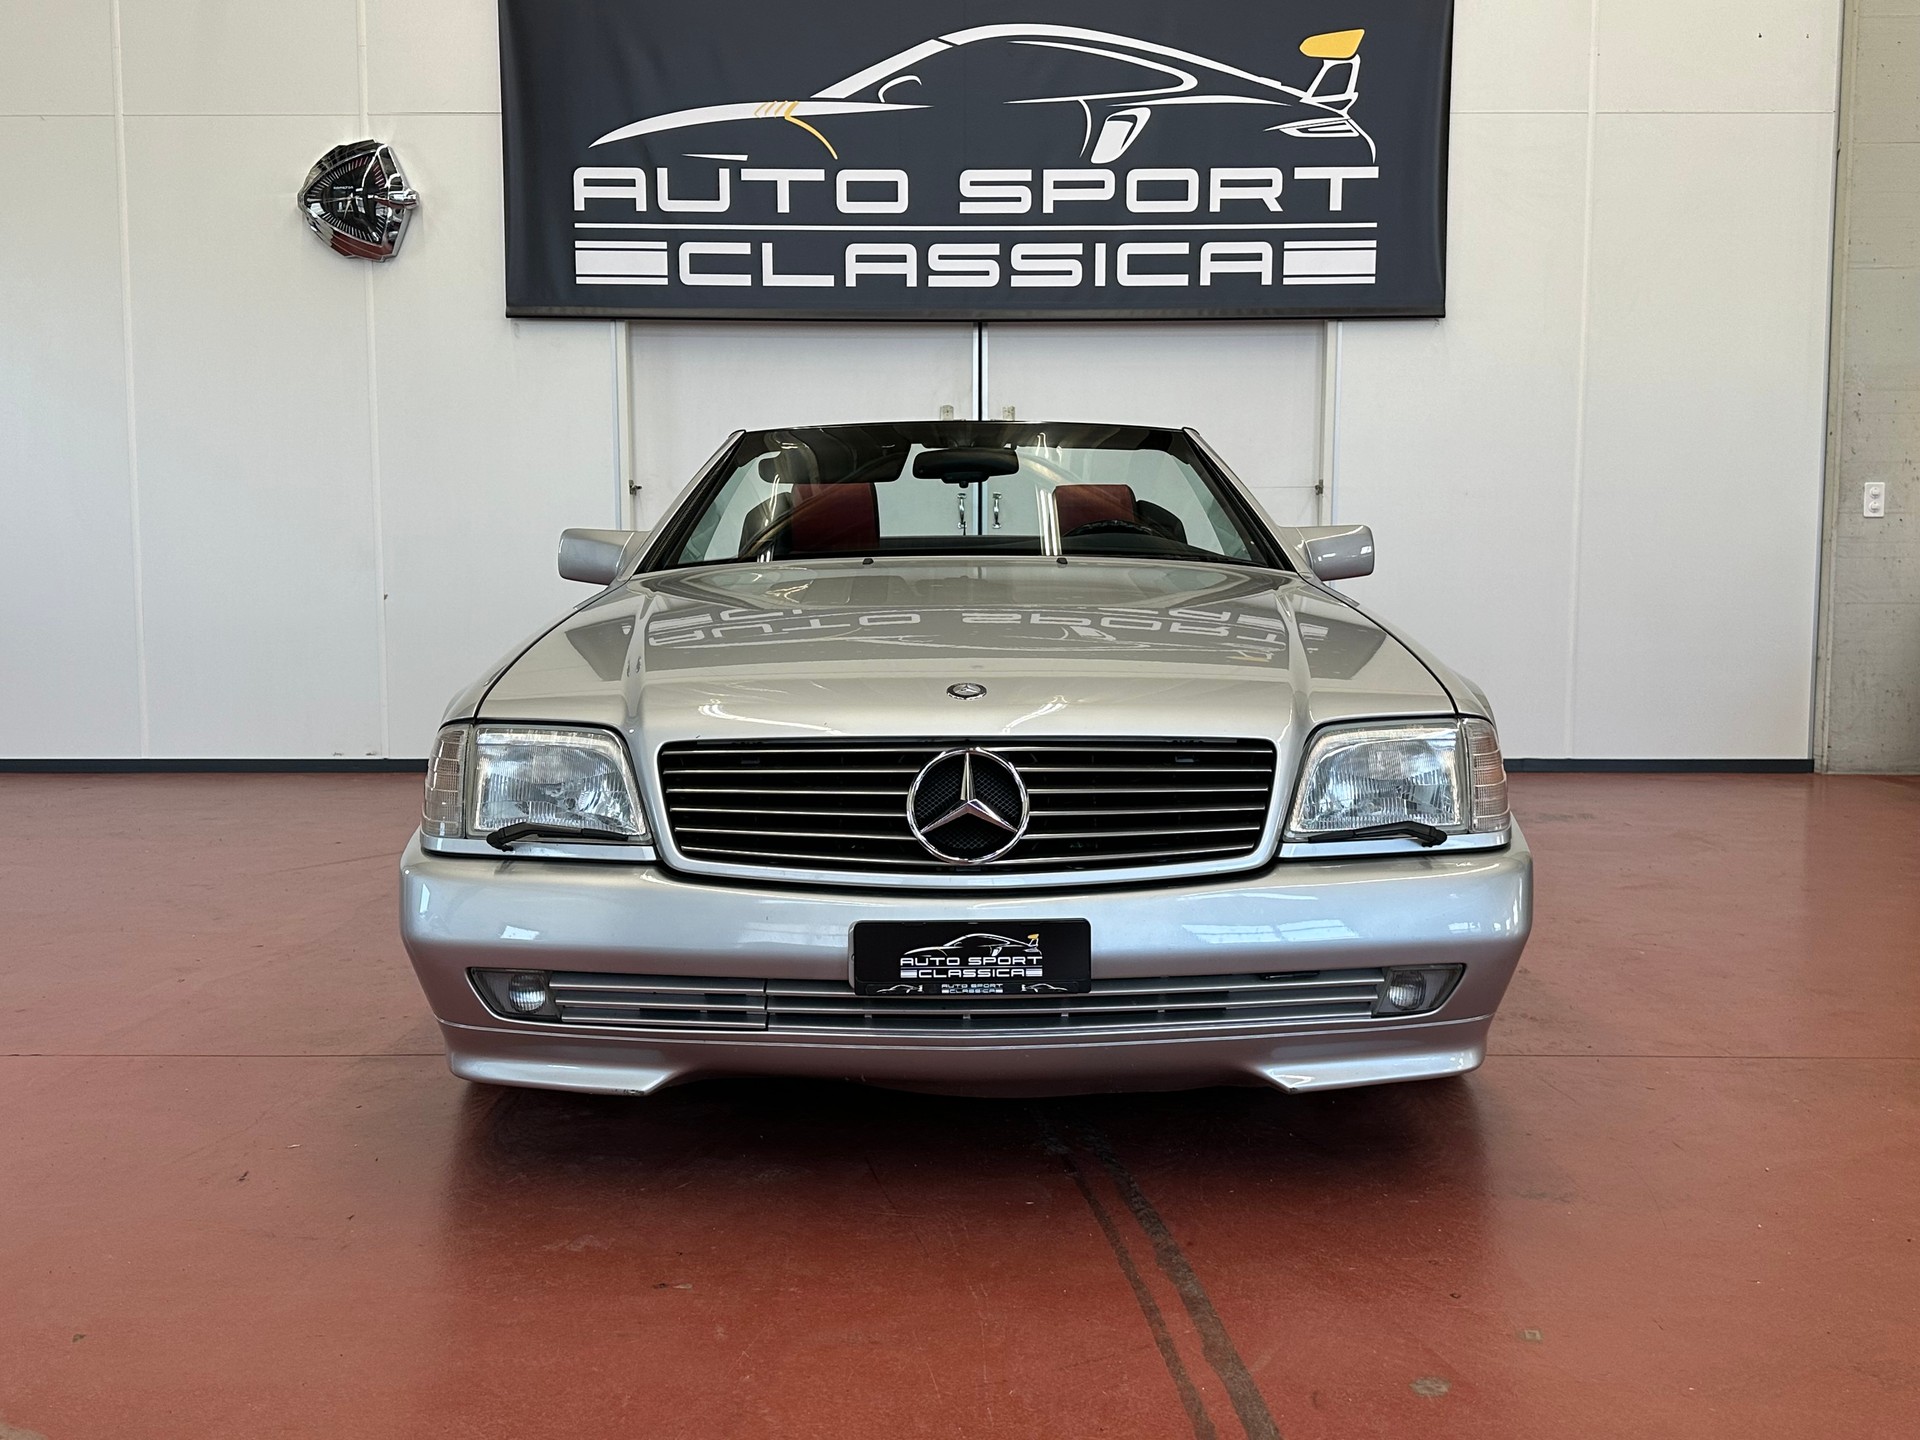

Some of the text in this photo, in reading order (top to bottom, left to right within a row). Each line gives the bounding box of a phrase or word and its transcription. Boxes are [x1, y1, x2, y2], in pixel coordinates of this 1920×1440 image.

[573, 166, 1380, 214] AUTO SPORT
[678, 241, 1273, 288] CLASSICA
[900, 956, 1043, 966] AUTO SPORT
[918, 968, 1025, 978] CLASSICA
